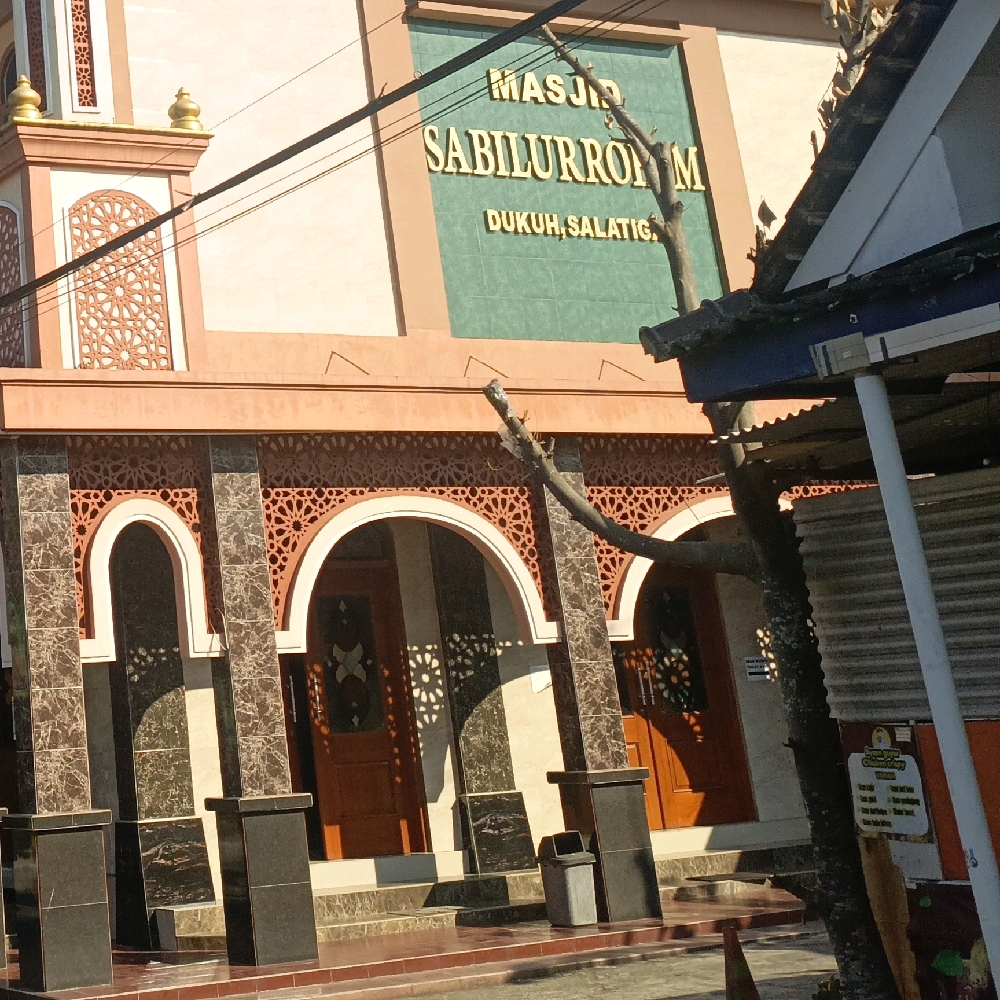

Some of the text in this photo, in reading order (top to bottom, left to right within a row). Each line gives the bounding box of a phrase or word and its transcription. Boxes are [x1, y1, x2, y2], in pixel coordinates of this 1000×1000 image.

[487, 68, 622, 109] MASJID
[422, 124, 706, 191] SABILURROM
[567, 213, 660, 242] SALATIG
